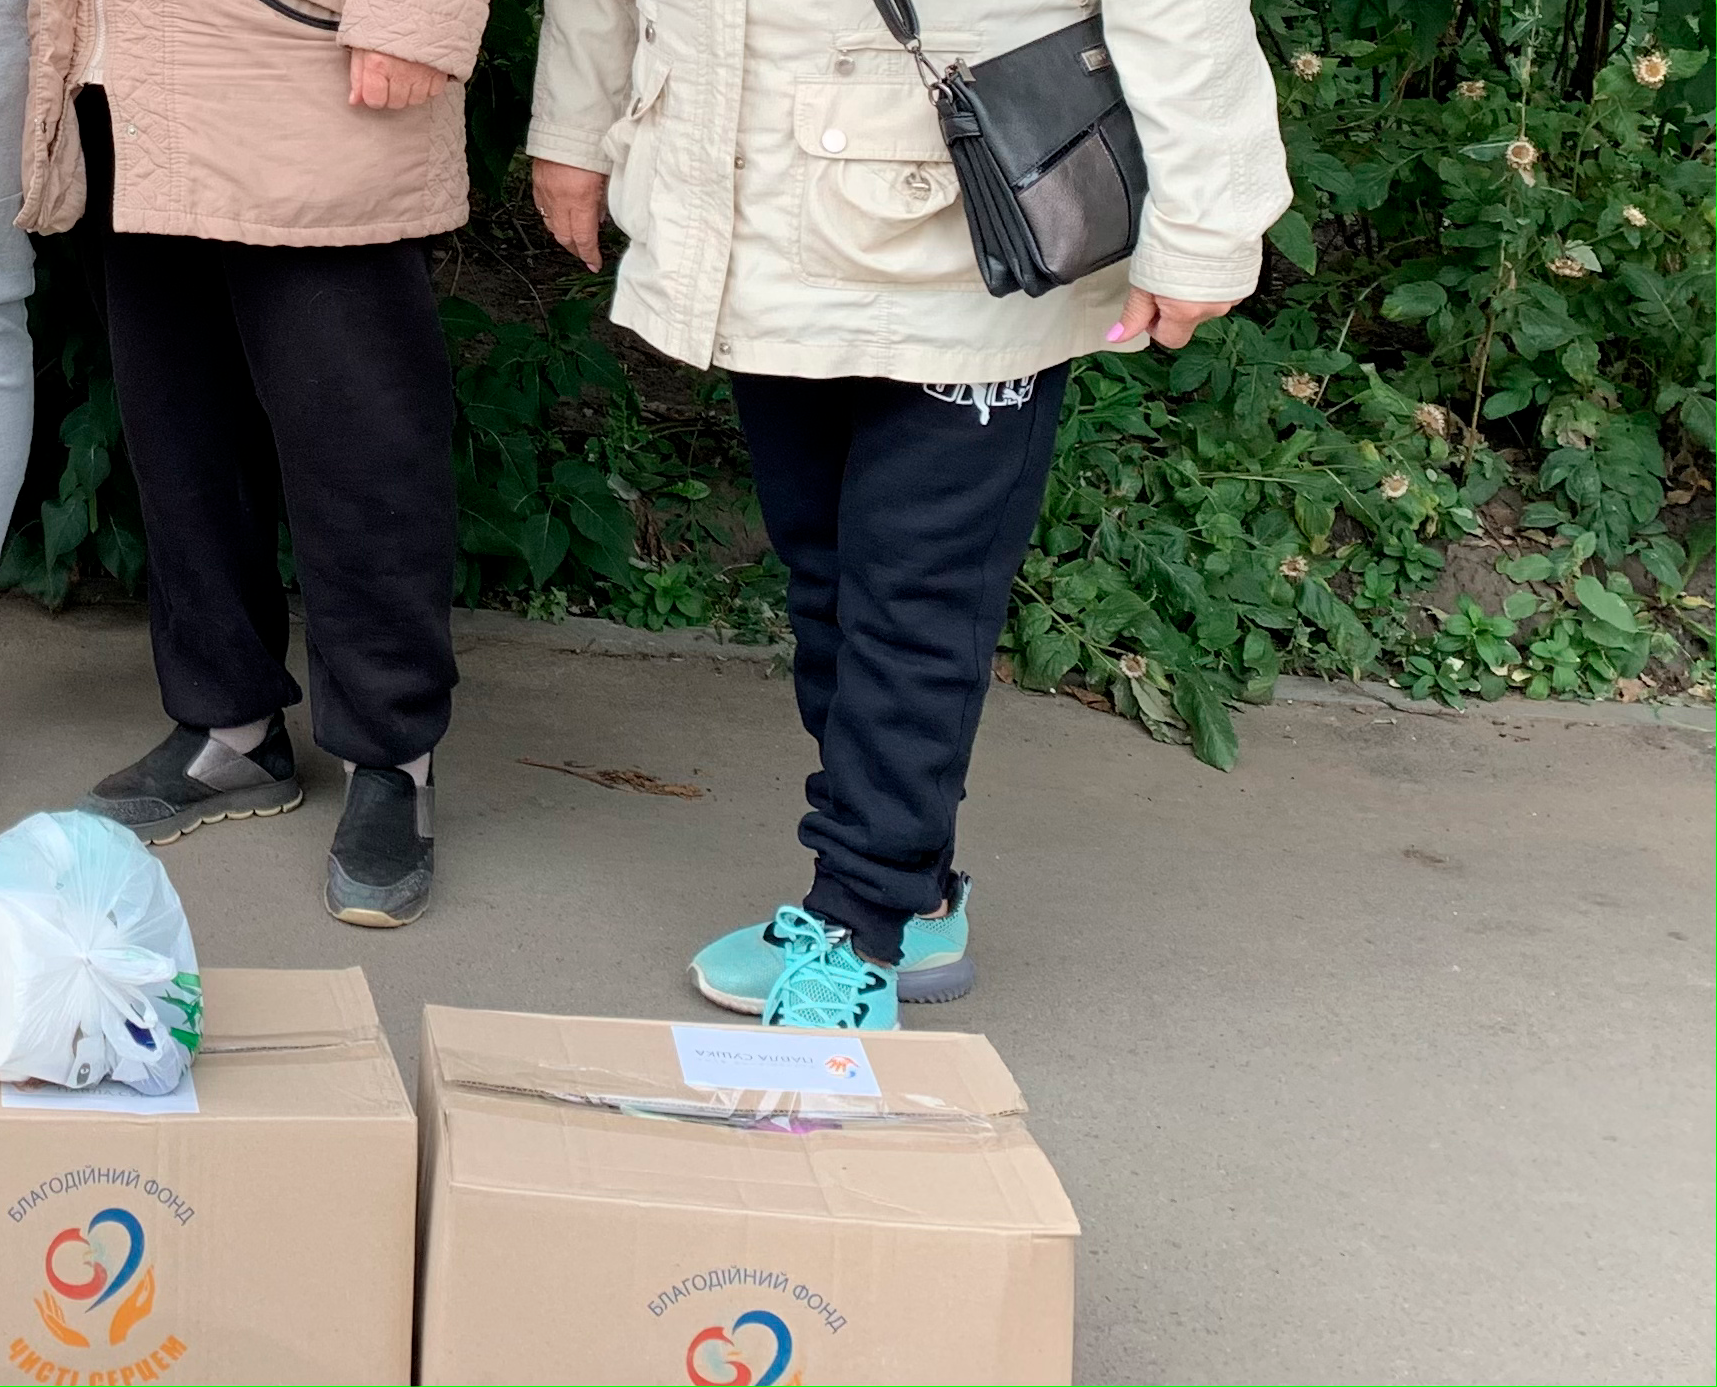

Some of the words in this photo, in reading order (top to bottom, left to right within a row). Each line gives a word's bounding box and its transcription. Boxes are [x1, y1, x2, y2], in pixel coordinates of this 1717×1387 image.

[7, 1164, 142, 1224] БЛАГОДІЙНИЙ
[143, 1179, 196, 1226] ФОНД
[646, 1265, 790, 1318] БЛАГОДІЙНИЙ
[791, 1284, 849, 1335] ФОНД
